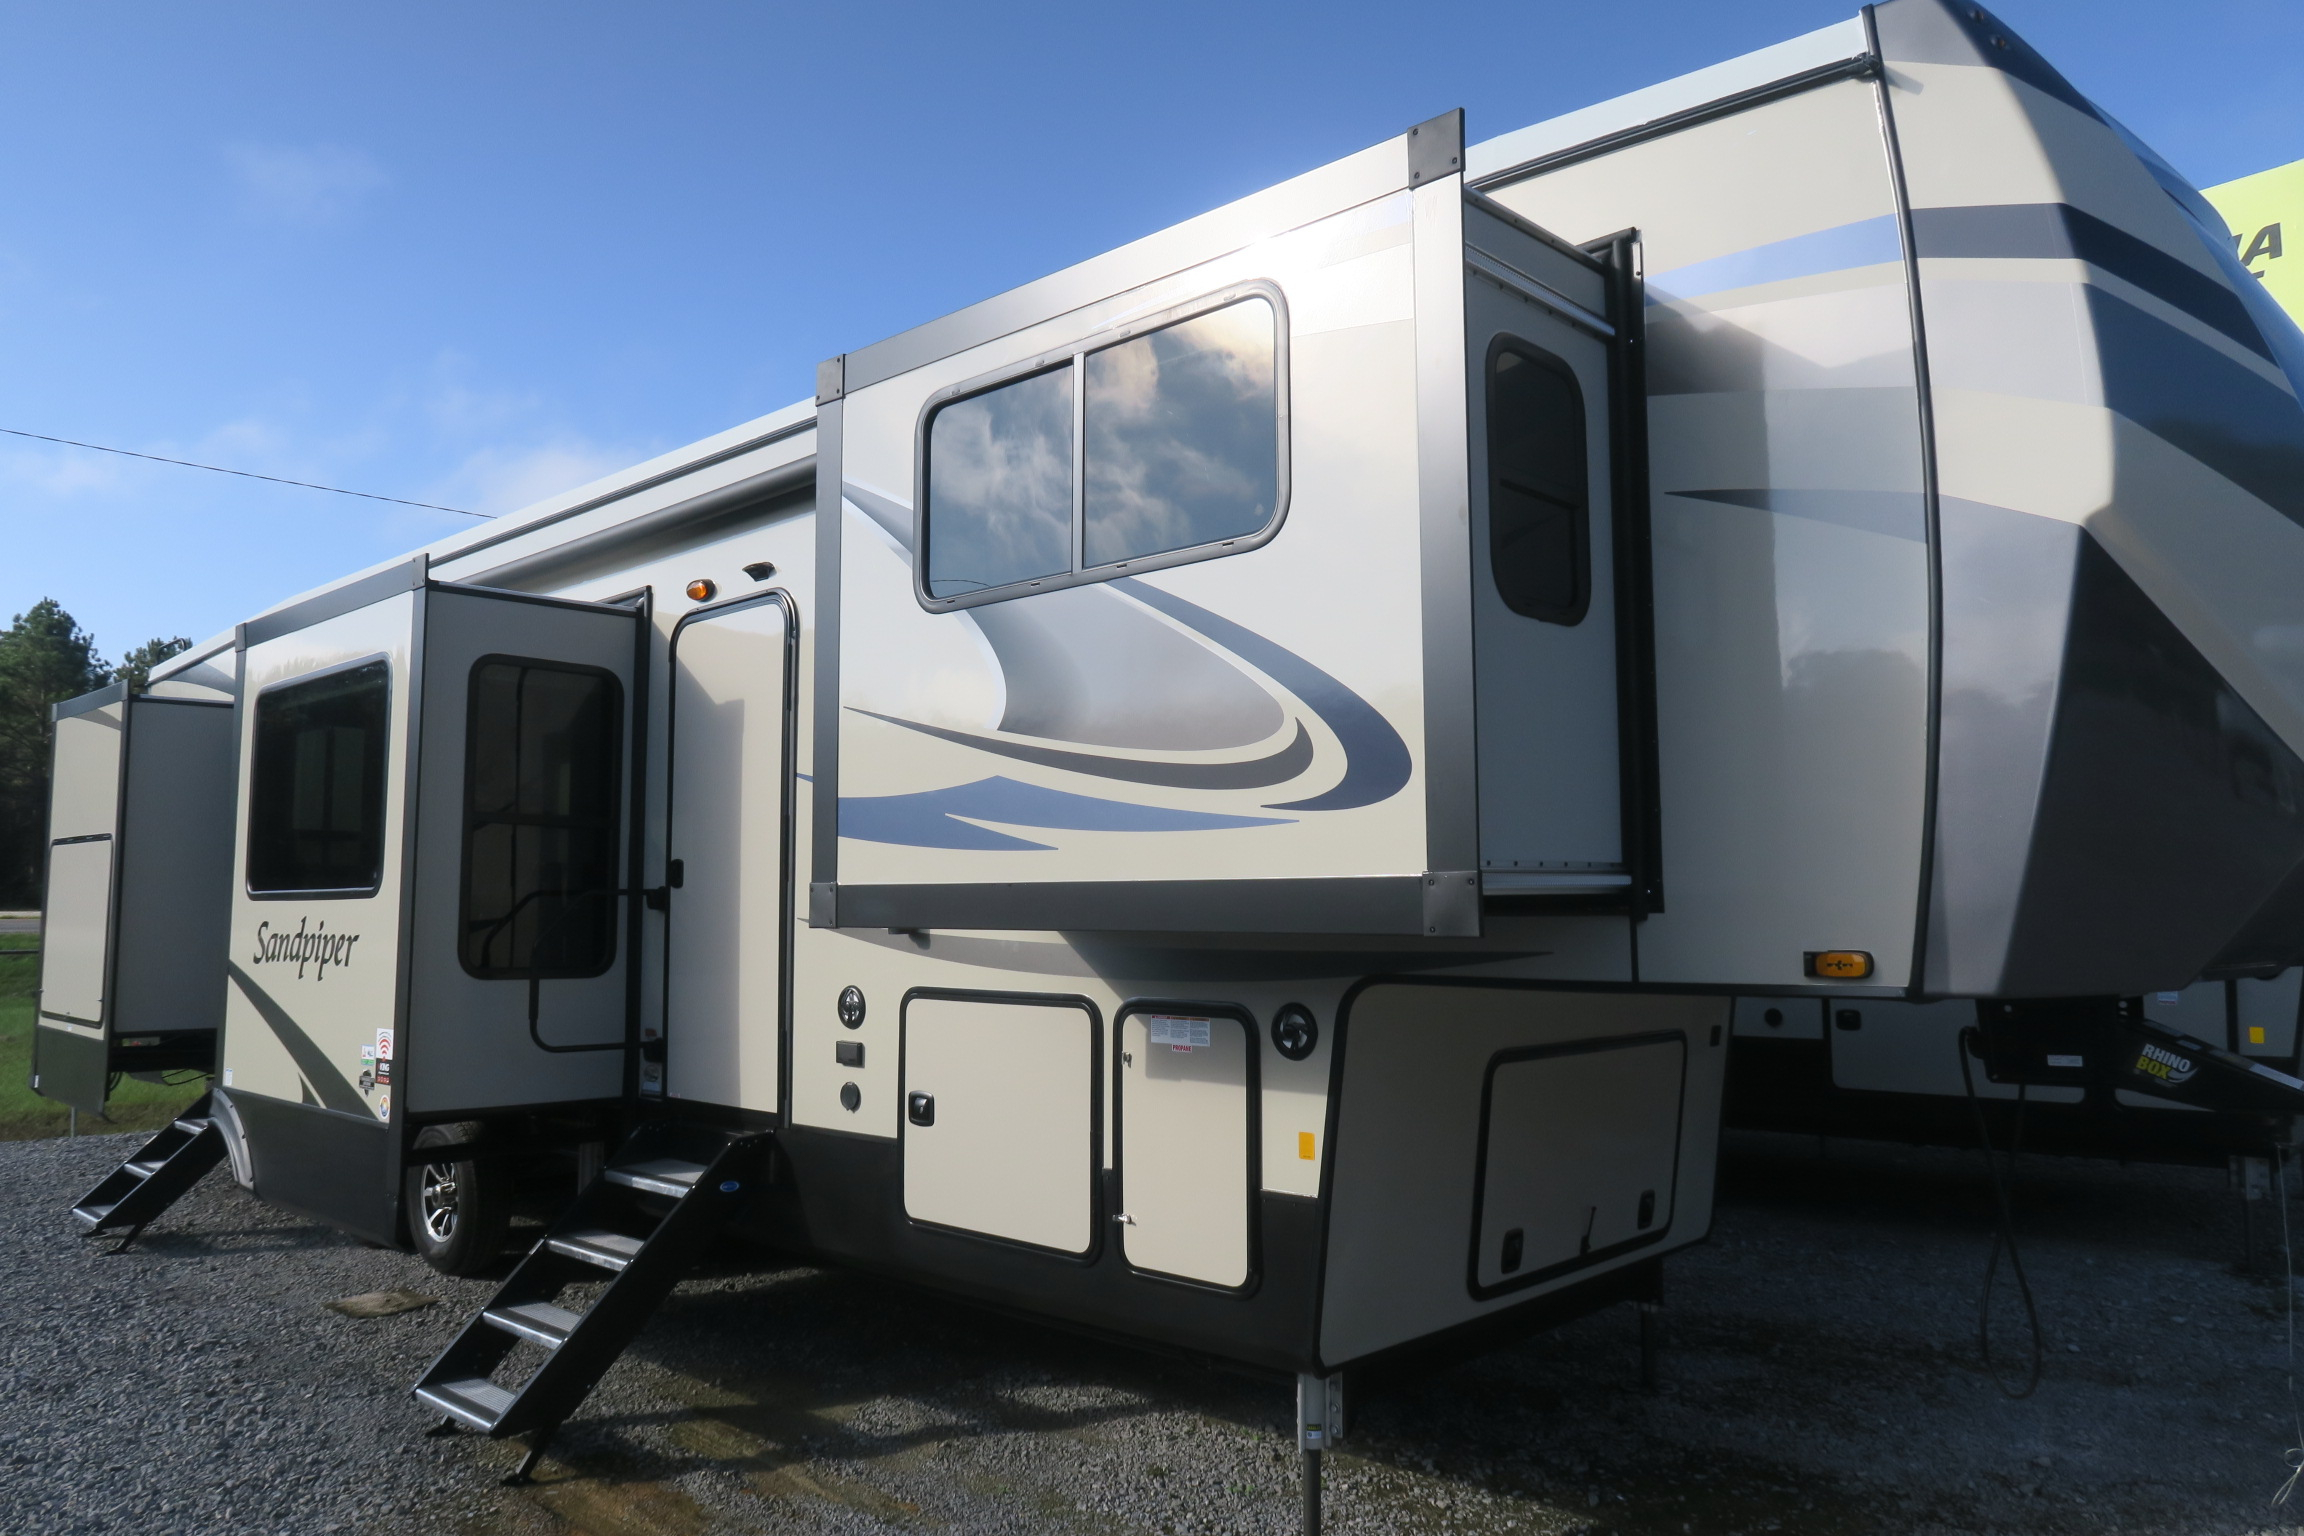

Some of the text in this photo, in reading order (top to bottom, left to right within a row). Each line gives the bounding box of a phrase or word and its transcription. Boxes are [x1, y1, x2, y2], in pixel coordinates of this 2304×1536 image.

[253, 915, 360, 981] Sandpiper
[1172, 1044, 1192, 1052] PROPANE
[2142, 1043, 2191, 1073] RHINO
[2136, 1055, 2173, 1080] BOX
